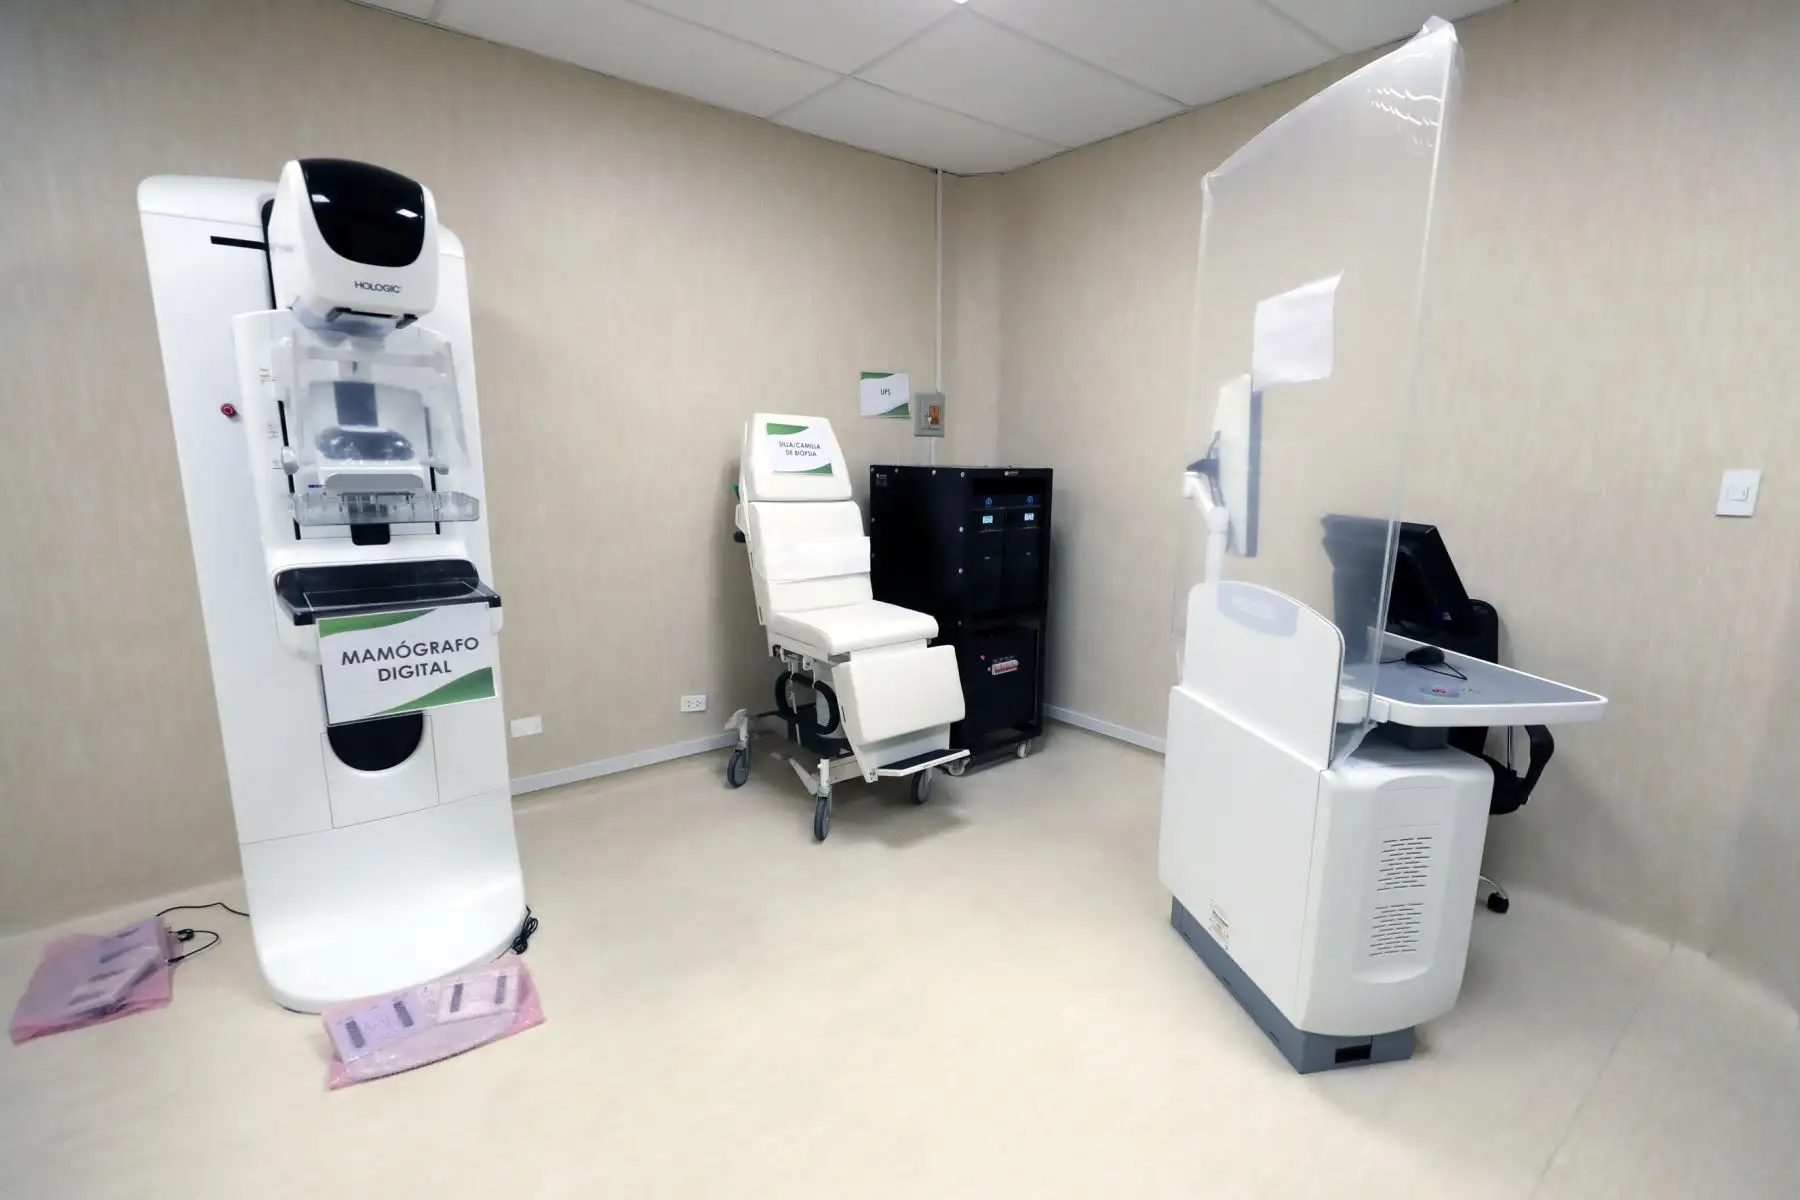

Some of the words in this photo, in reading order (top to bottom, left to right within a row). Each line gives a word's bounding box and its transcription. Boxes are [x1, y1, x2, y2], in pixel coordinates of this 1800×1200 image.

[354, 281, 401, 293] HOLOGIC
[880, 388, 891, 396] UPS
[341, 637, 479, 665] MAMÓGRAFO
[378, 660, 452, 681] DIGITAL
